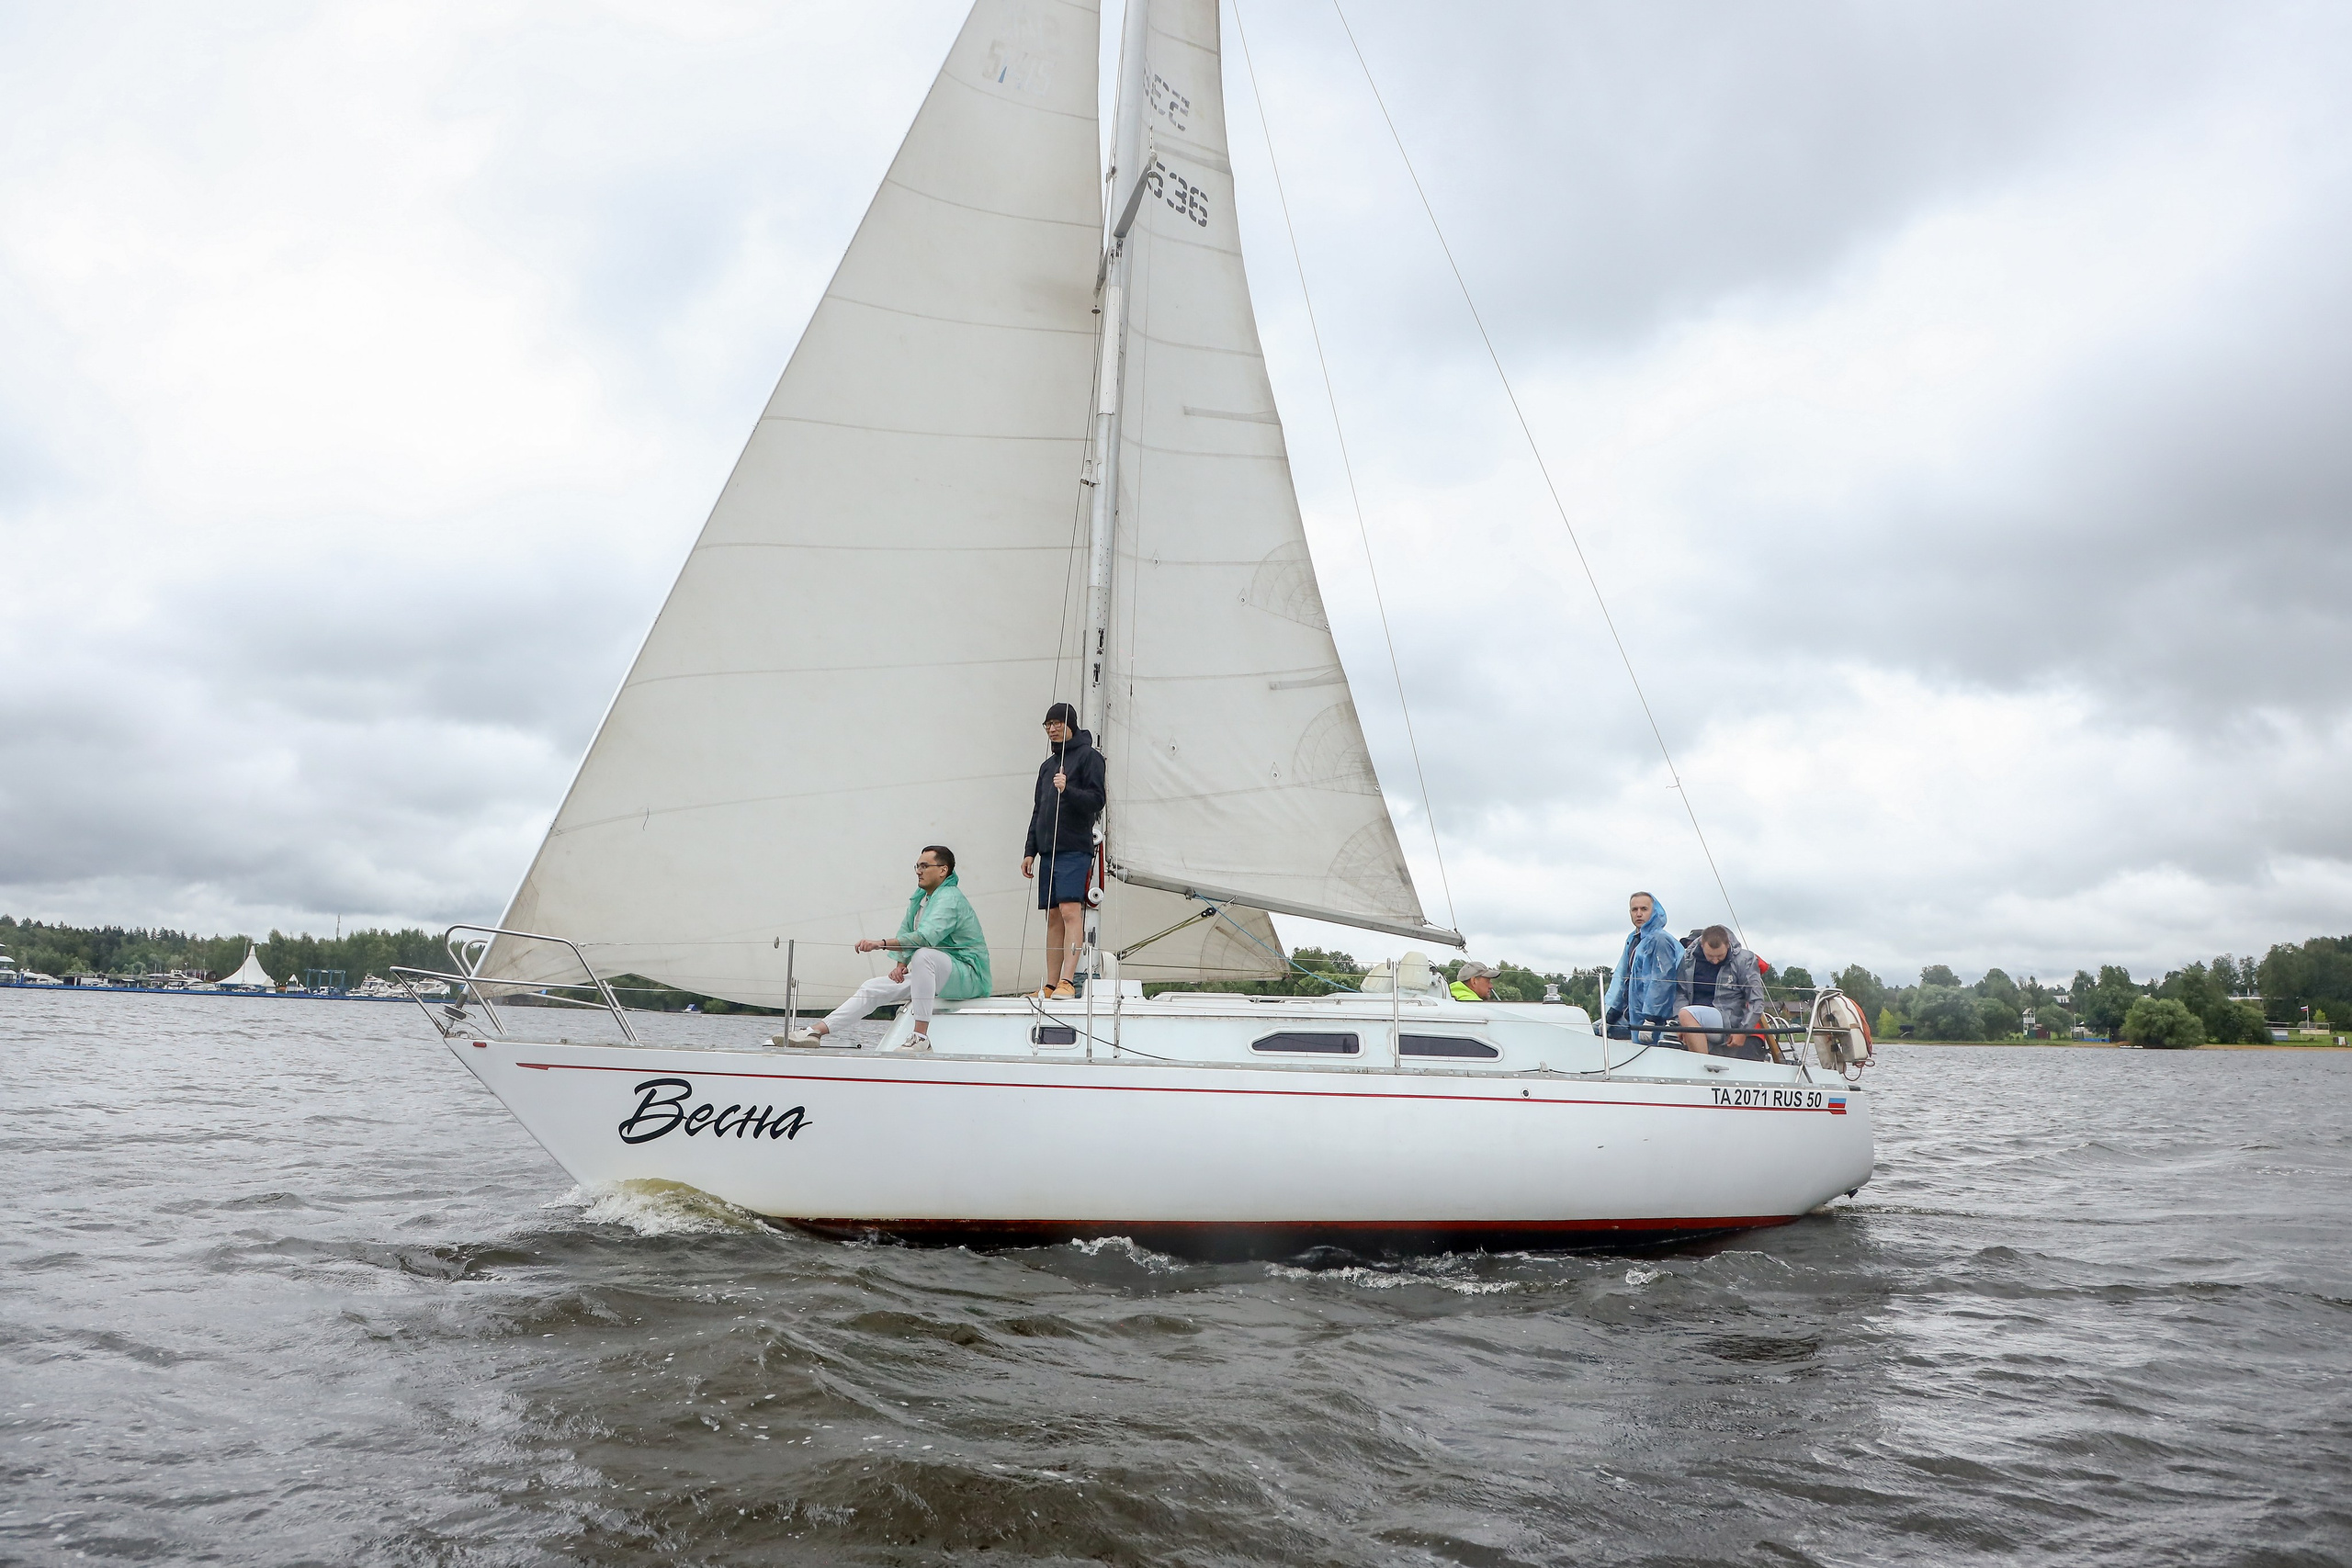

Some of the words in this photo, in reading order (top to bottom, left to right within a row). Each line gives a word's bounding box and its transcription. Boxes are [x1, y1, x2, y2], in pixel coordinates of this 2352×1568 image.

[618, 1077, 813, 1145] Весна
[1712, 1088, 1732, 1105] TA
[1734, 1089, 1768, 1106] 2071
[1773, 1090, 1803, 1108] RUS
[1806, 1091, 1822, 1108] 50
